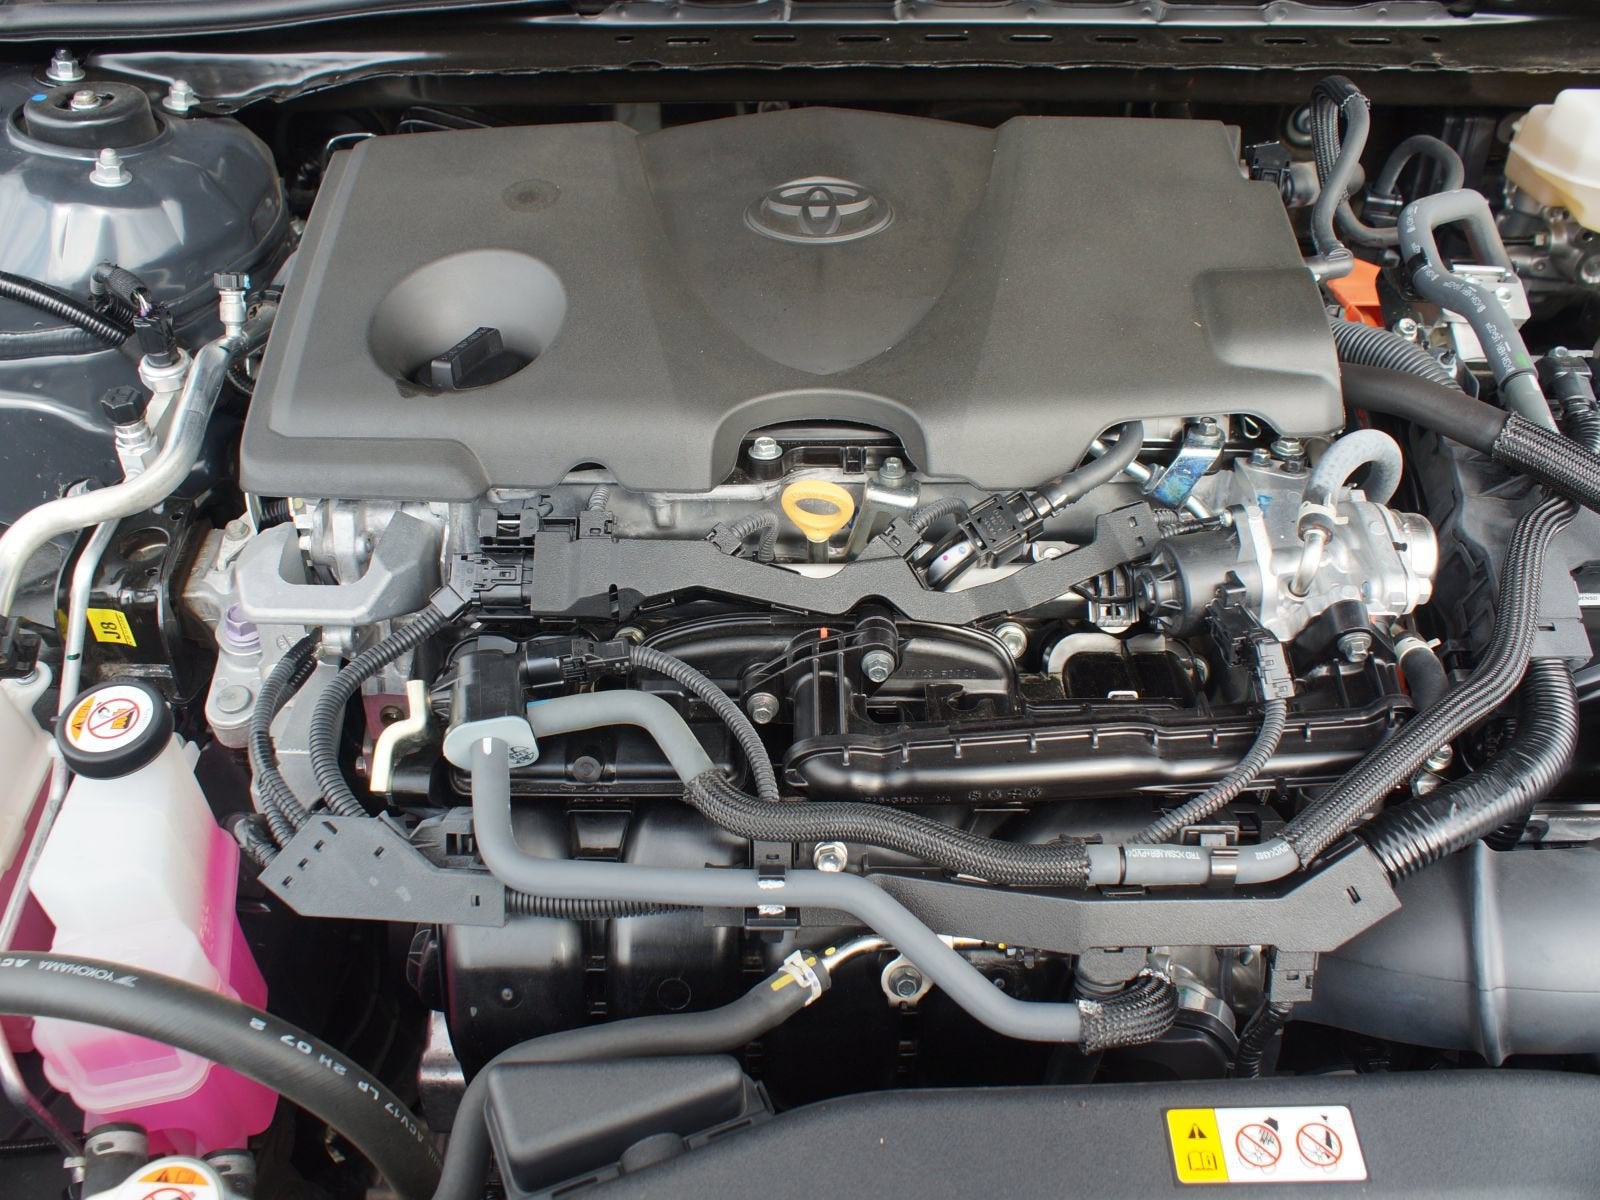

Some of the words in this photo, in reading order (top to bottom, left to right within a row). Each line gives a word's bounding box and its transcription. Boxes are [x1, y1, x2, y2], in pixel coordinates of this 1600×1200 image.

[100, 621, 121, 639] J8
[0, 958, 31, 968] AC
[38, 959, 115, 982] YOKOHAMA
[279, 1034, 313, 1055] 07
[318, 1053, 348, 1076] 2H
[357, 1080, 380, 1101] LP
[384, 1101, 424, 1143] ACV17
